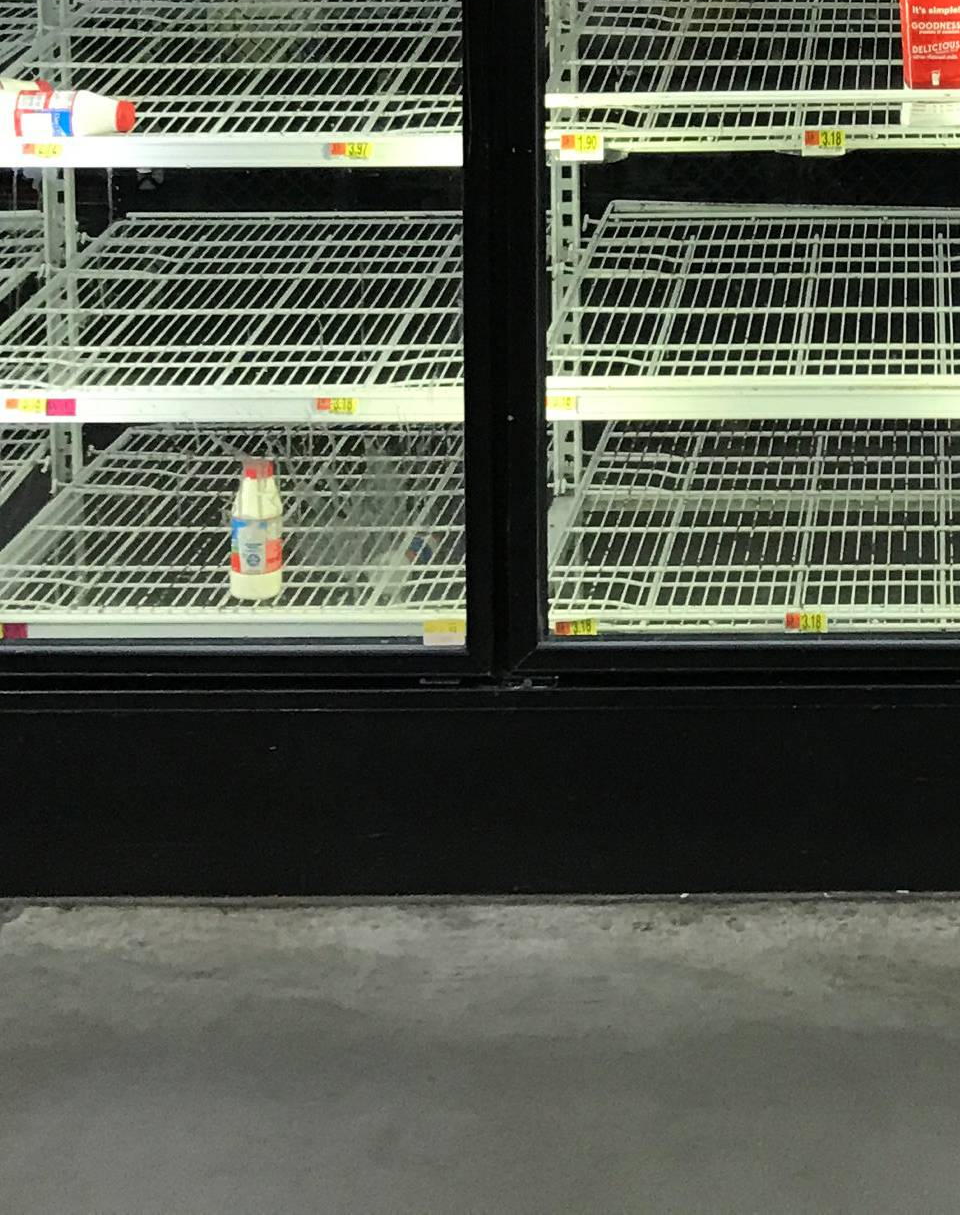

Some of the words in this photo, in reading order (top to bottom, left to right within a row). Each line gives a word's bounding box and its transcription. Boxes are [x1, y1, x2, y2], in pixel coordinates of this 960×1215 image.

[911, 21, 960, 30] GOODNESS
[912, 40, 960, 54] DELICIOUS
[821, 131, 842, 146] 3.18
[572, 619, 592, 634] 3.18
[802, 614, 822, 629] 3.18
